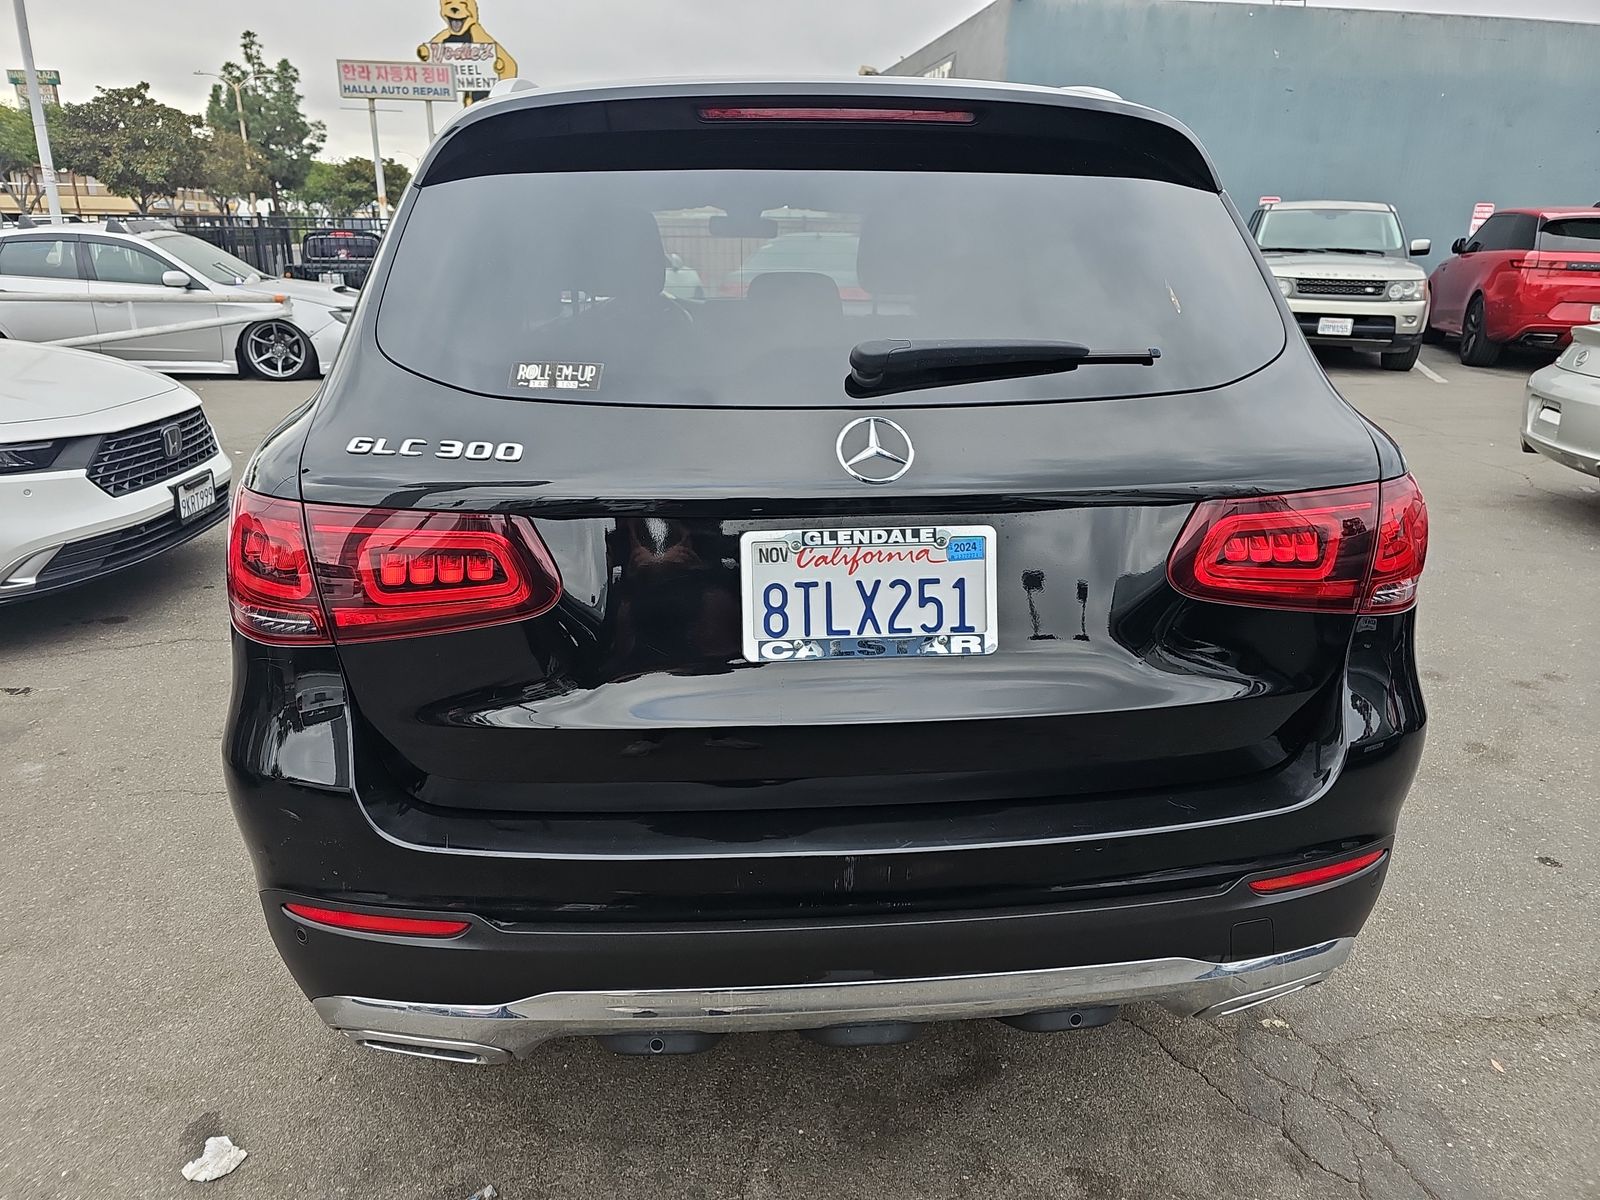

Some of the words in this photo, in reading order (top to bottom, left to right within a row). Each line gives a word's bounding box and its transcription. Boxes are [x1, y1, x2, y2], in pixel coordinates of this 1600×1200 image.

[342, 64, 371, 82] 한라
[376, 66, 418, 83] 자동차
[455, 64, 482, 76] EEL
[343, 85, 377, 95] HALLA
[381, 86, 409, 95] AUTO
[413, 87, 450, 97] REPAIR
[457, 77, 498, 89] NMENT
[346, 436, 427, 456] GLC
[435, 440, 524, 462] 300
[804, 529, 936, 546] GLENDALE
[758, 547, 789, 563] NOV
[797, 546, 947, 575] California
[953, 542, 977, 552] 2024
[763, 577, 976, 639] 8TLX251
[760, 635, 983, 660] CALSTAR
